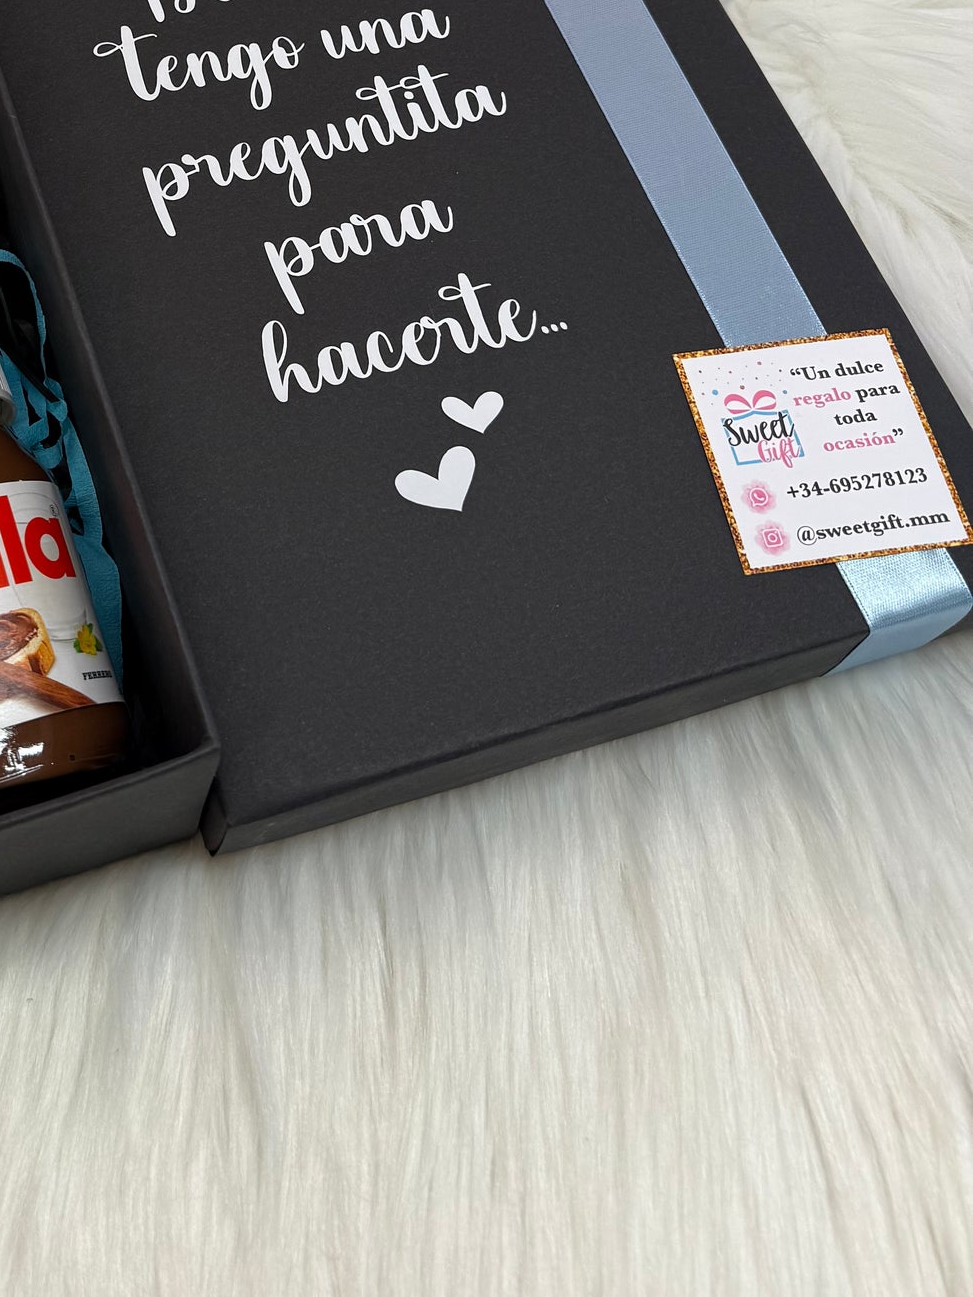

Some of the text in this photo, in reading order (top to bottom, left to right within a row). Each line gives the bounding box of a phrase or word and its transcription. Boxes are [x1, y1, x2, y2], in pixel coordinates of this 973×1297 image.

[93, 8, 451, 111] tengo una
[141, 64, 507, 237] preguntita
[264, 198, 454, 315] para
[834, 360, 885, 378] dulce
[793, 383, 901, 408] regalo para
[722, 411, 795, 448] Sweet
[833, 409, 878, 426] toda
[757, 437, 802, 469] Gift
[786, 467, 928, 499] +34-695278123
[796, 511, 951, 546] @sweetgift.mm
